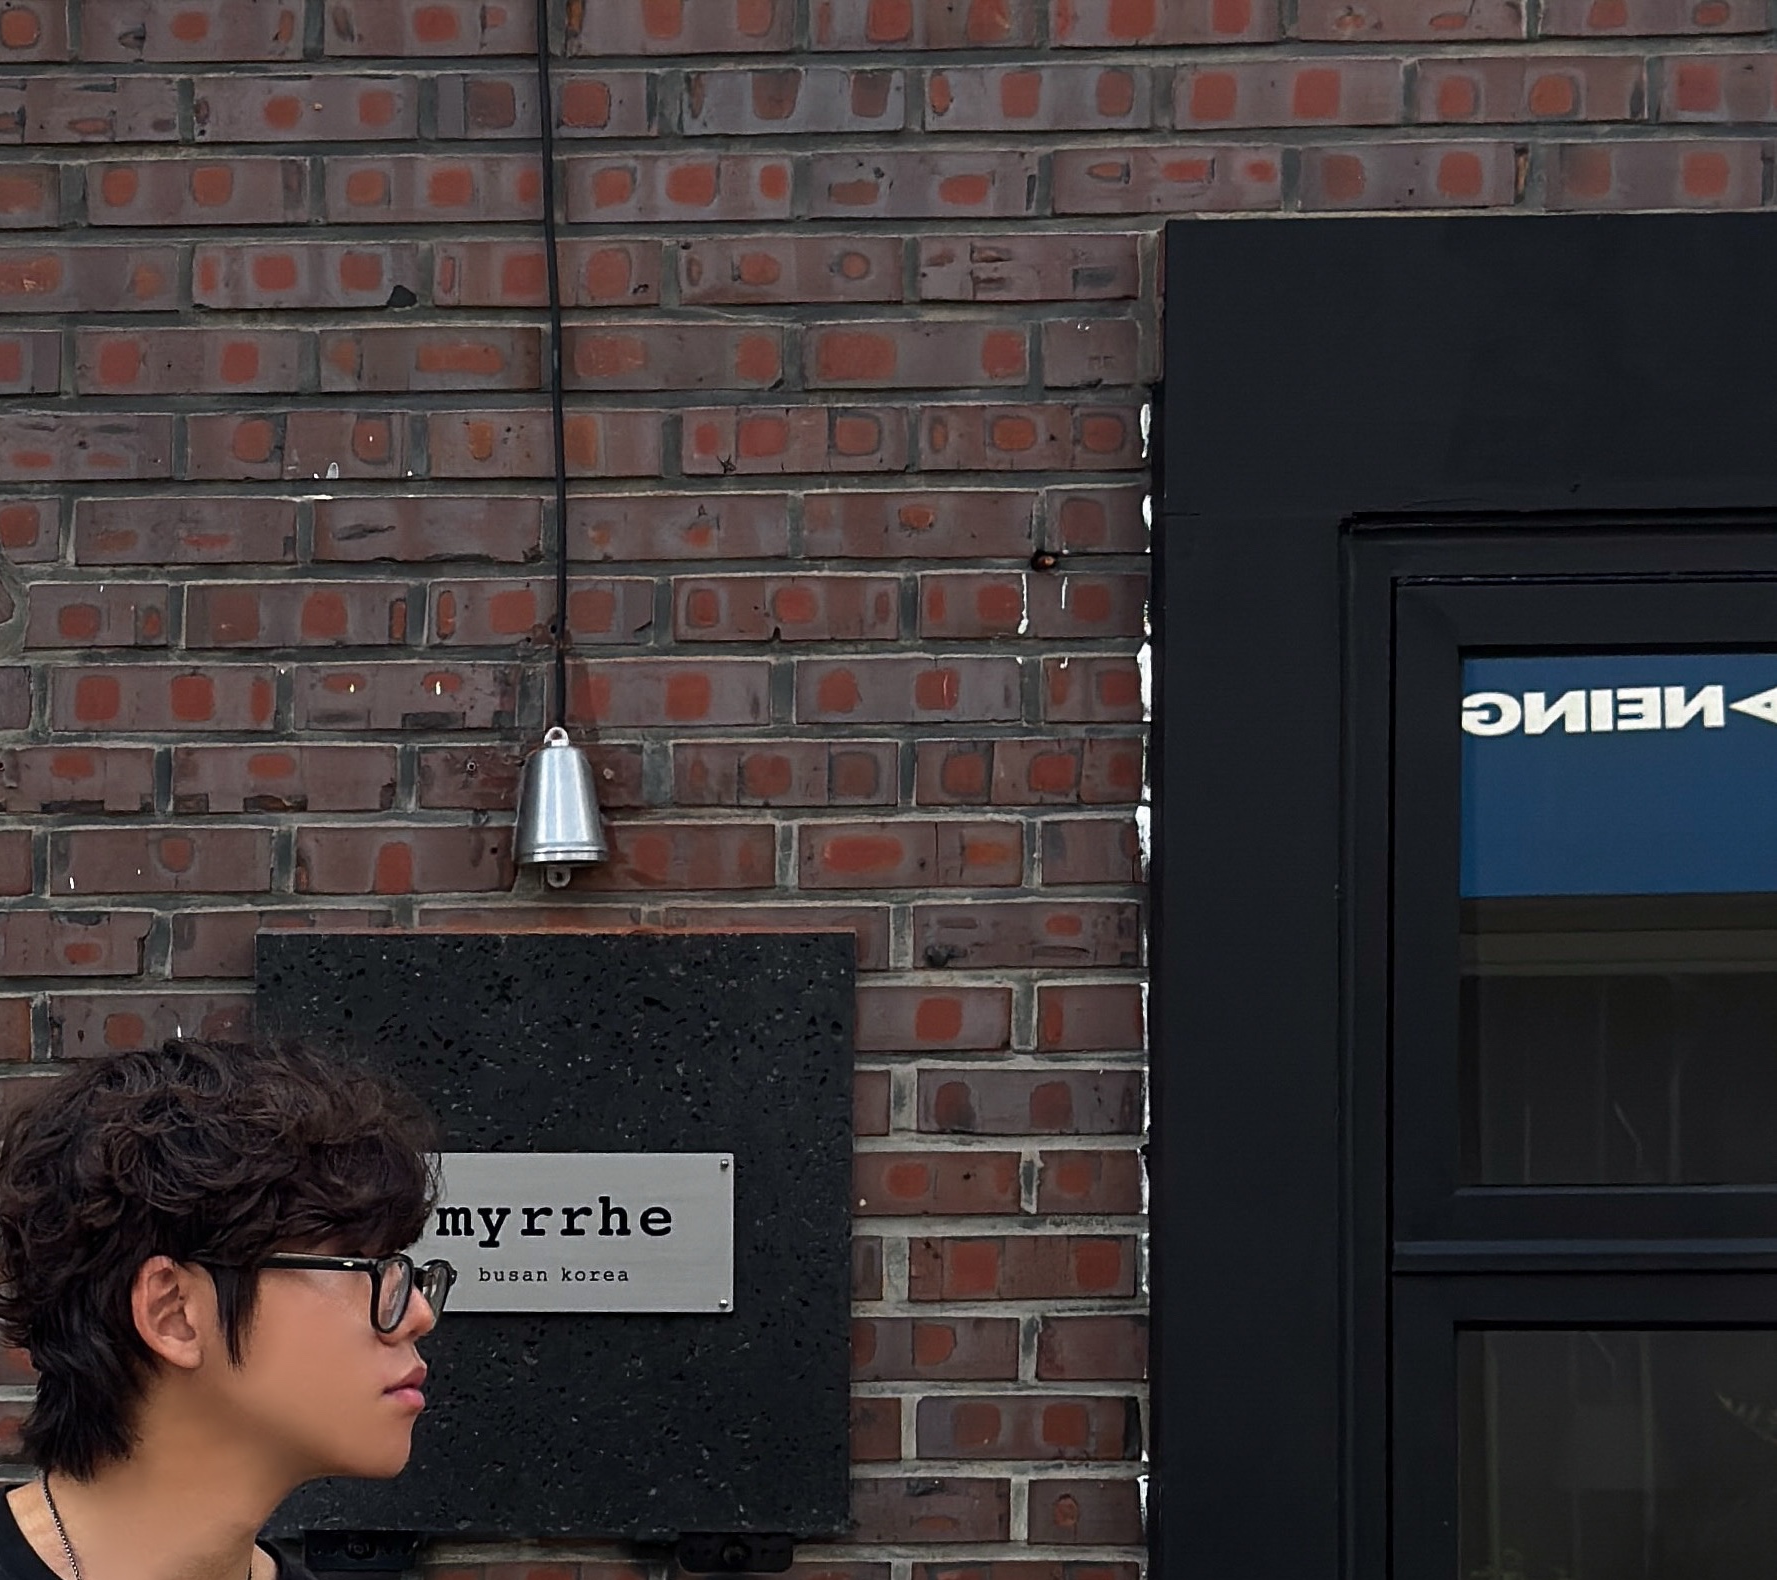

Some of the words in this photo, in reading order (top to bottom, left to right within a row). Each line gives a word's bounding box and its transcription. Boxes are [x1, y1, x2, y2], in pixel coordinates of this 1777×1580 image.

[435, 1195, 673, 1249] myrrhe
[478, 1267, 549, 1283] busan
[561, 1267, 630, 1283] korea
